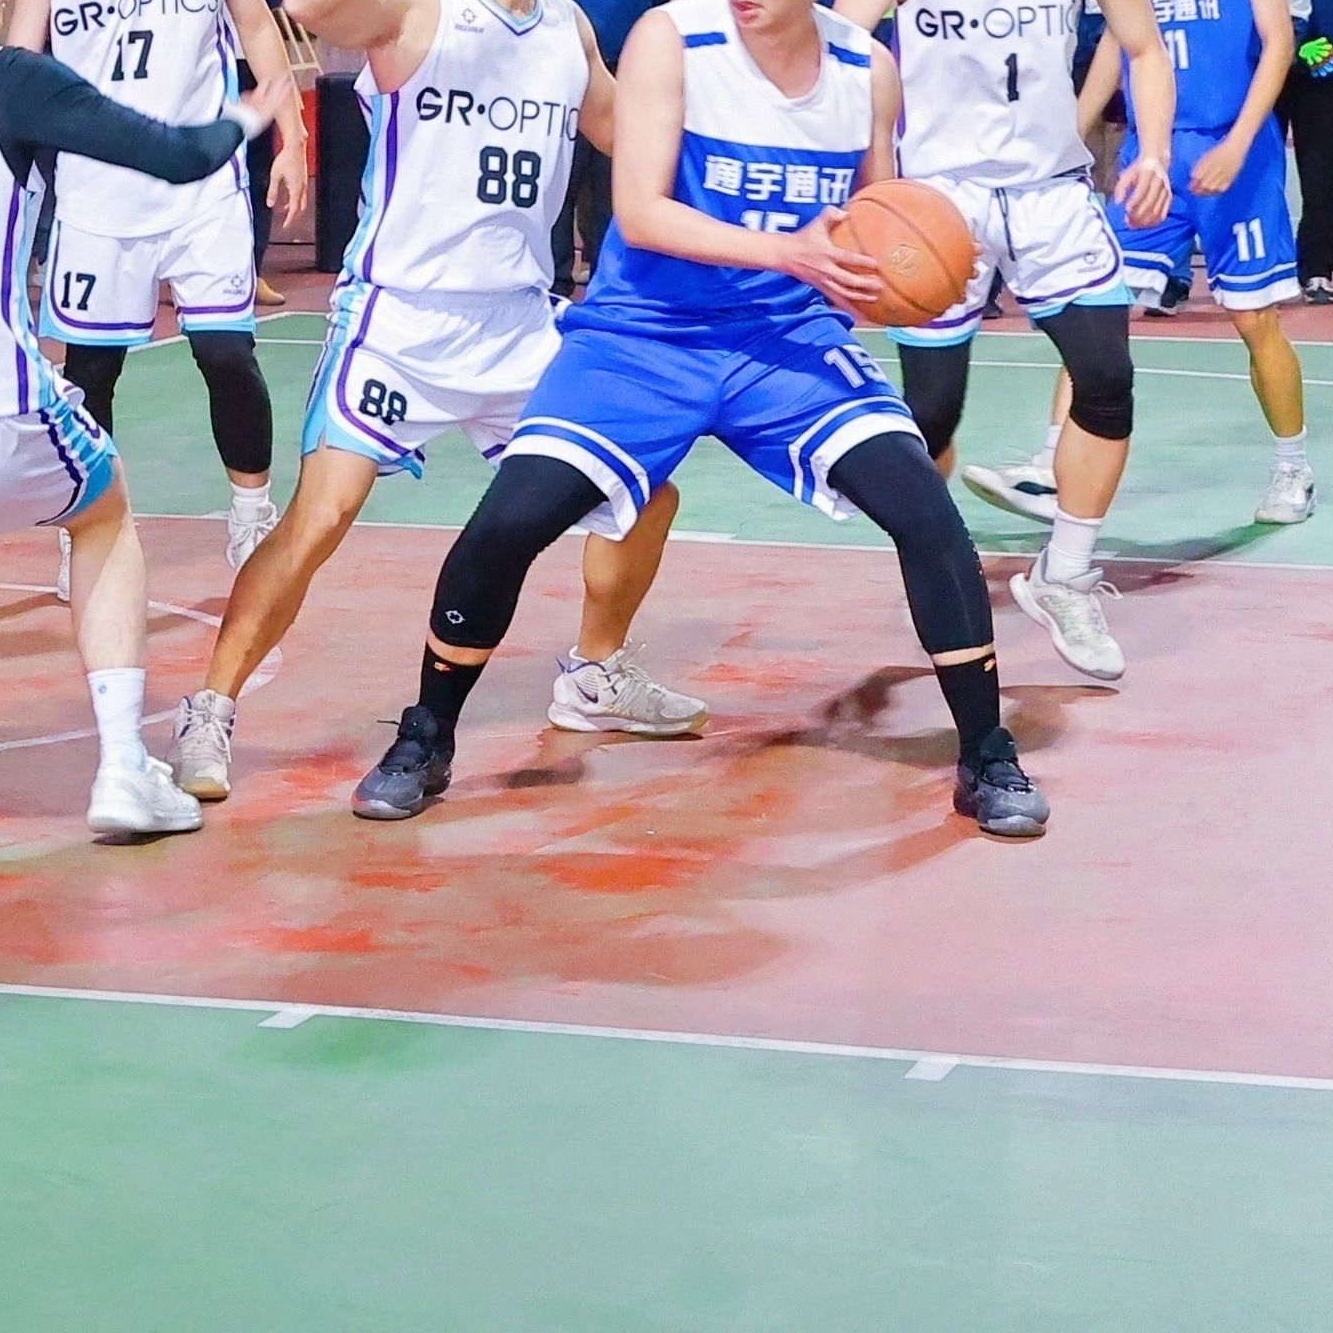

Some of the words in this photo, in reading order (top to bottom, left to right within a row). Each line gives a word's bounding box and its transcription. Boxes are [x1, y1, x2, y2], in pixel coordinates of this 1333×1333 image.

[111, 30, 154, 81] 17
[1005, 53, 1019, 102] 1
[477, 145, 541, 208] 88
[703, 154, 855, 204] 通宇通讯
[1232, 217, 1265, 262] 11
[61, 271, 96, 311] 17
[359, 377, 407, 425] 88
